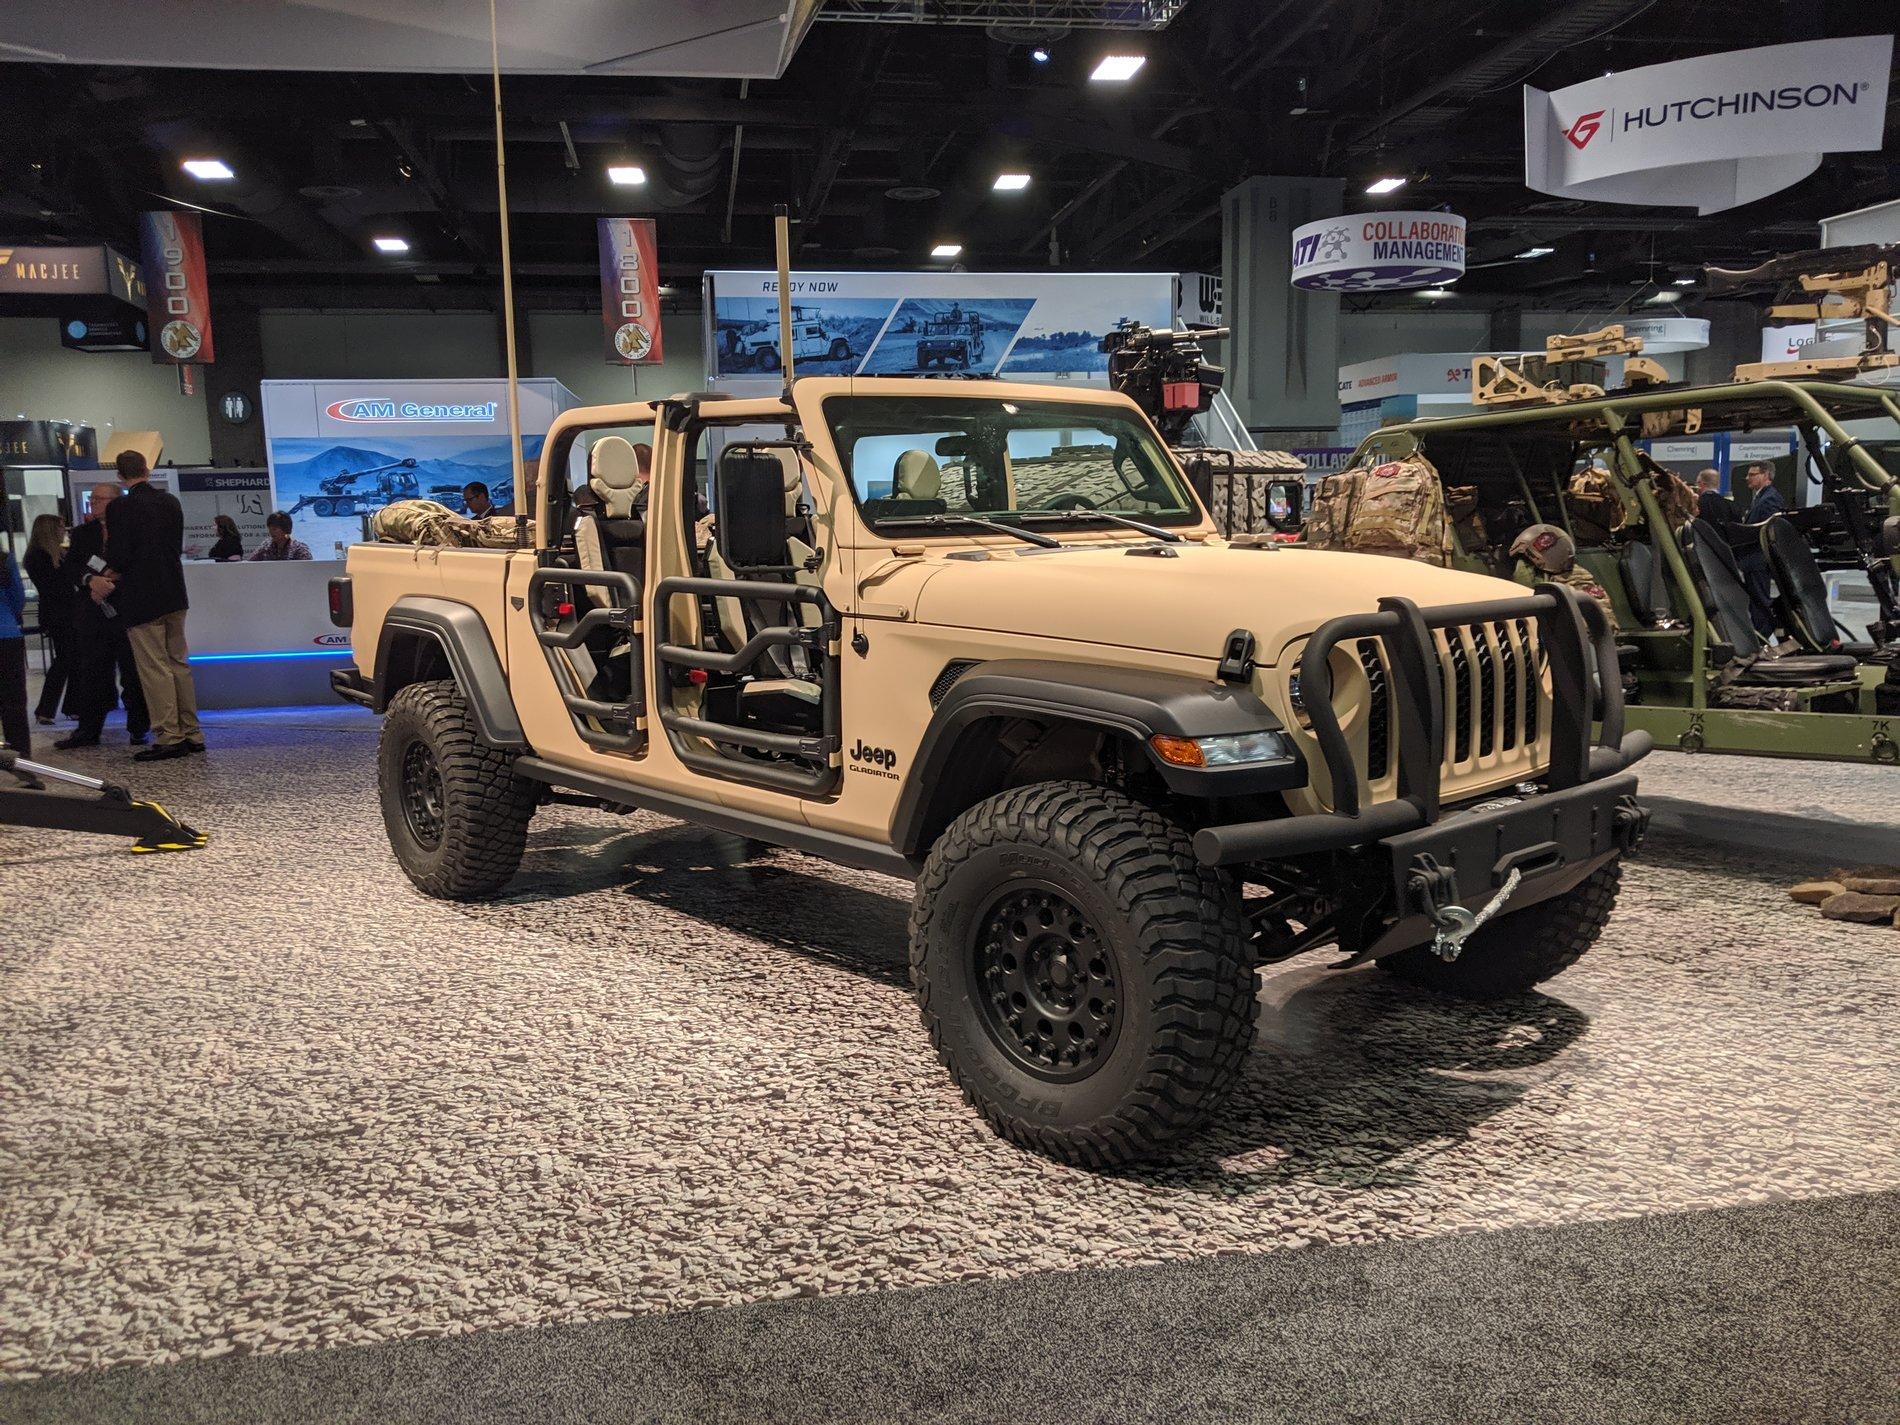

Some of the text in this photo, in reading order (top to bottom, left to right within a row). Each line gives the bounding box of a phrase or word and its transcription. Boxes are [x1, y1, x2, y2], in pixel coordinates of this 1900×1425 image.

[16, 263, 80, 280] MACJEE
[763, 281, 839, 292] REDY NOW
[353, 402, 494, 418] AM General
[1872, 720, 1890, 731] 7K
[850, 738, 897, 770] Jeep
[849, 764, 901, 781] GLADIATOR
